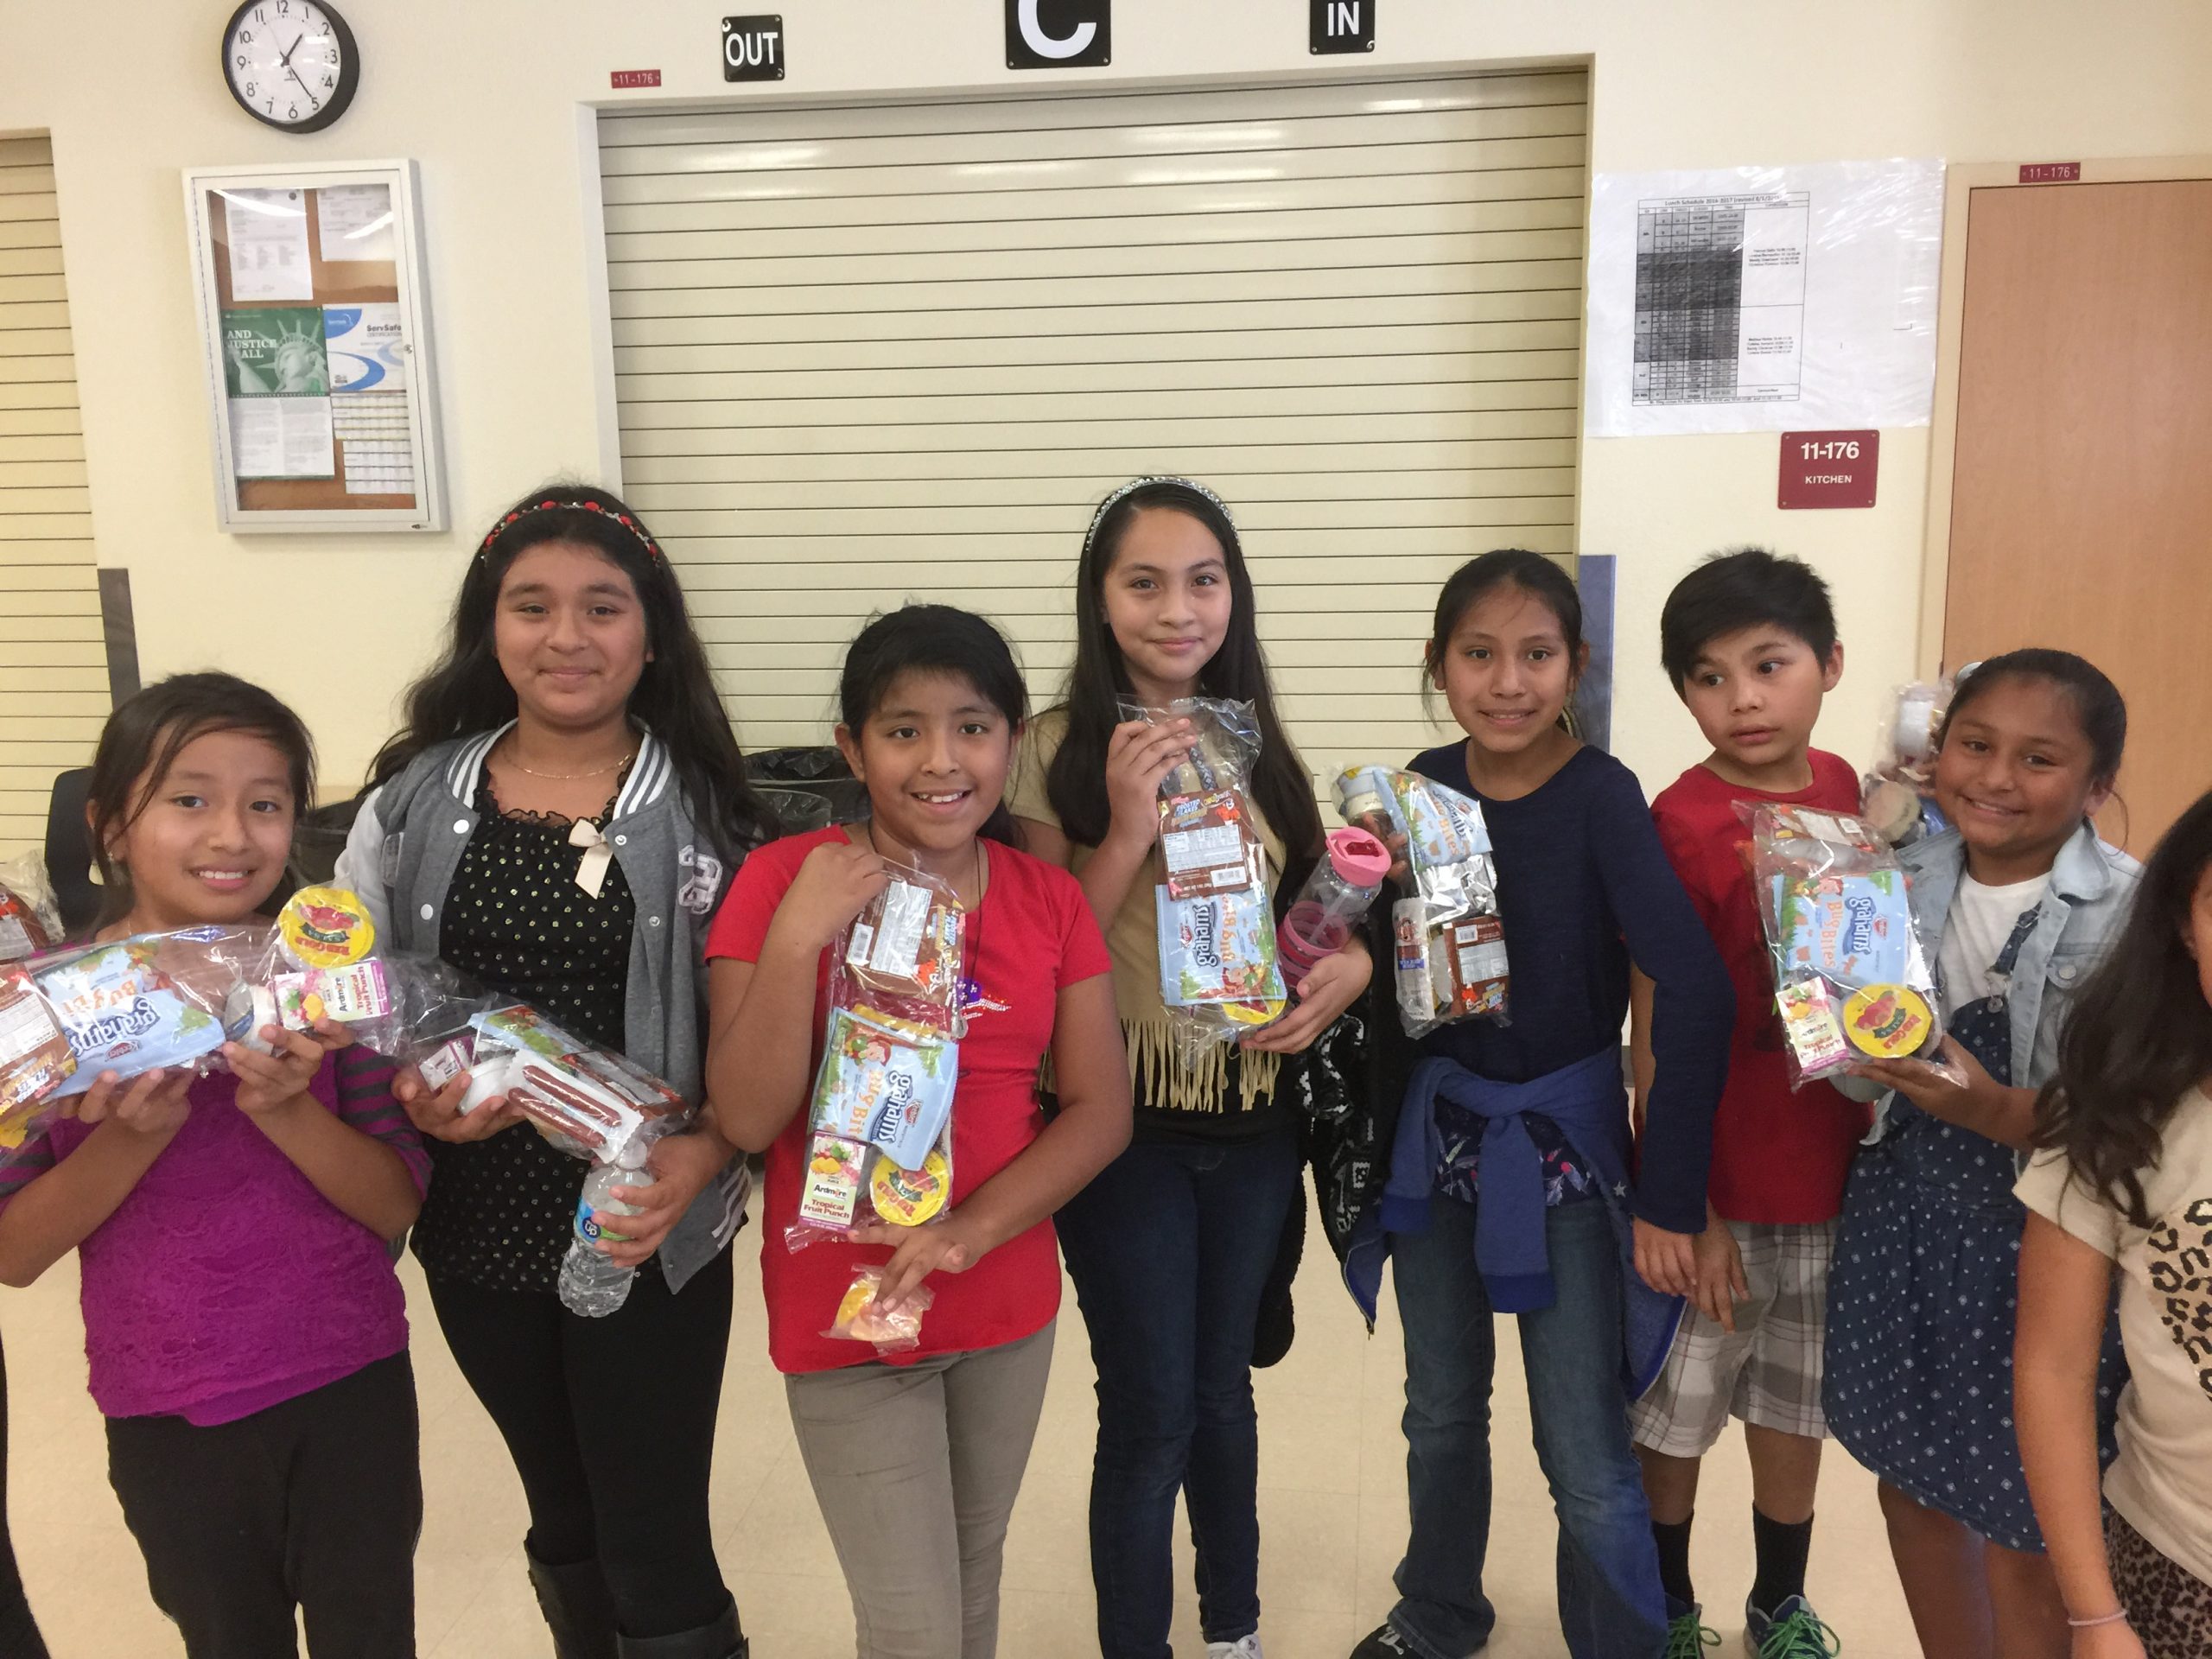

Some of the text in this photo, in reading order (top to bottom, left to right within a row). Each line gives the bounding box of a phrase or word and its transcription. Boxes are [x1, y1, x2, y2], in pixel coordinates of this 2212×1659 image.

[276, 0, 289, 13] 12
[305, 7, 308, 19] 1
[255, 10, 264, 22] 11
[1327, 2, 1360, 36] IN
[321, 22, 330, 35] 2
[1018, 0, 1097, 59] C
[239, 30, 251, 44] 10
[726, 32, 778, 66] OUT
[237, 55, 246, 70] 9
[330, 49, 338, 64] 3
[324, 74, 334, 88] 4
[619, 73, 652, 85] 11-176
[246, 82, 255, 97] 8
[266, 101, 273, 114] 7
[312, 98, 320, 111] 5
[289, 105, 298, 118] 6
[2030, 167, 2070, 179] 11-176
[227, 330, 251, 339] AND
[242, 350, 264, 359] ALL
[1801, 442, 1859, 460] 11-176
[1805, 475, 1852, 484] KITCHEN
[1824, 901, 1842, 928] Bug
[1849, 898, 1872, 953] grahams
[1193, 905, 1217, 967] grahams
[335, 977, 347, 1011] Ardmore
[70, 998, 156, 1056] grahams
[879, 1071, 911, 1142] grahams
[814, 1185, 847, 1197] Ardmore
[804, 1205, 849, 1218] Fruit Punch
[812, 1199, 844, 1211] Tropical
